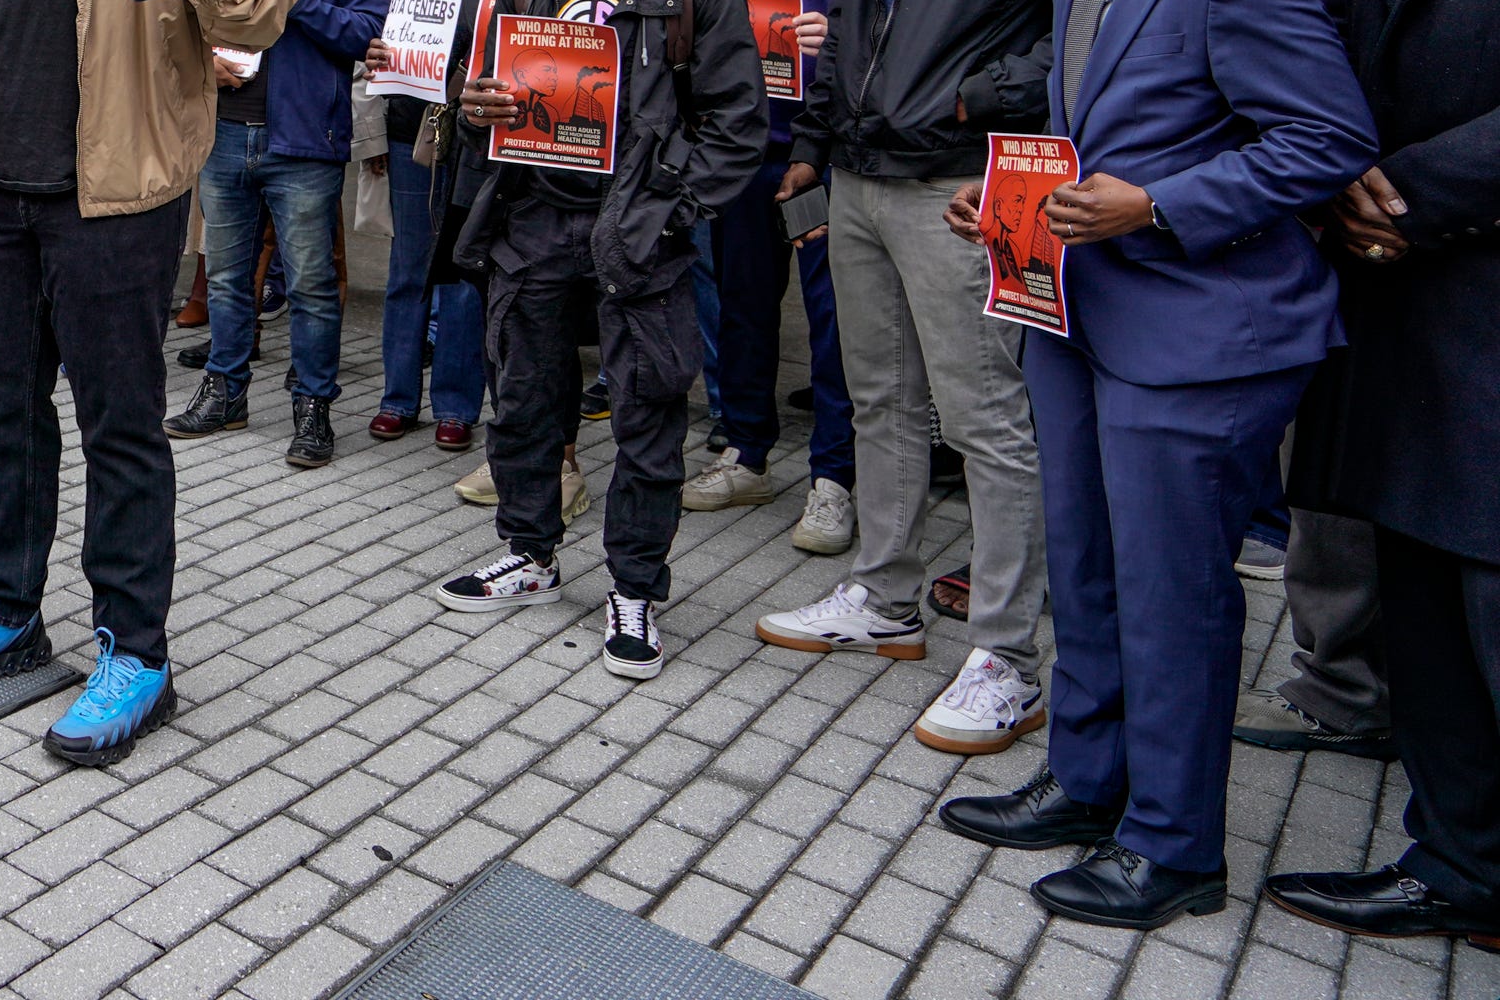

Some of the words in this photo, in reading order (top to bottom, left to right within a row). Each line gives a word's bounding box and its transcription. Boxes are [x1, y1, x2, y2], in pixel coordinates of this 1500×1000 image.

[400, 20, 415, 43] the
[419, 32, 445, 46] new
[516, 20, 541, 33] WHO
[543, 23, 566, 35] ARE
[568, 24, 595, 37] THEY
[510, 33, 556, 48] PUTTING
[558, 36, 572, 48] AT
[574, 37, 606, 50] RISK?
[373, 47, 446, 81] DLINING
[557, 124, 577, 133] OLDER
[578, 127, 601, 135] ADULTS
[503, 137, 535, 148] PROTECT
[536, 140, 552, 150] OUR
[552, 143, 599, 156] COMMUNITY
[557, 135, 581, 144] HEALTH
[581, 137, 601, 146] RISKS
[1002, 140, 1020, 154] WHO
[1021, 141, 1038, 156] ARE
[1038, 142, 1060, 157] THEY
[501, 148, 601, 166] #PROTECTMARTINDALEBRIGHTWOOD
[997, 156, 1032, 172] PUTTING
[1032, 158, 1043, 173] AT
[1044, 159, 1069, 175] RISK?
[999, 288, 1020, 302] PROTECT
